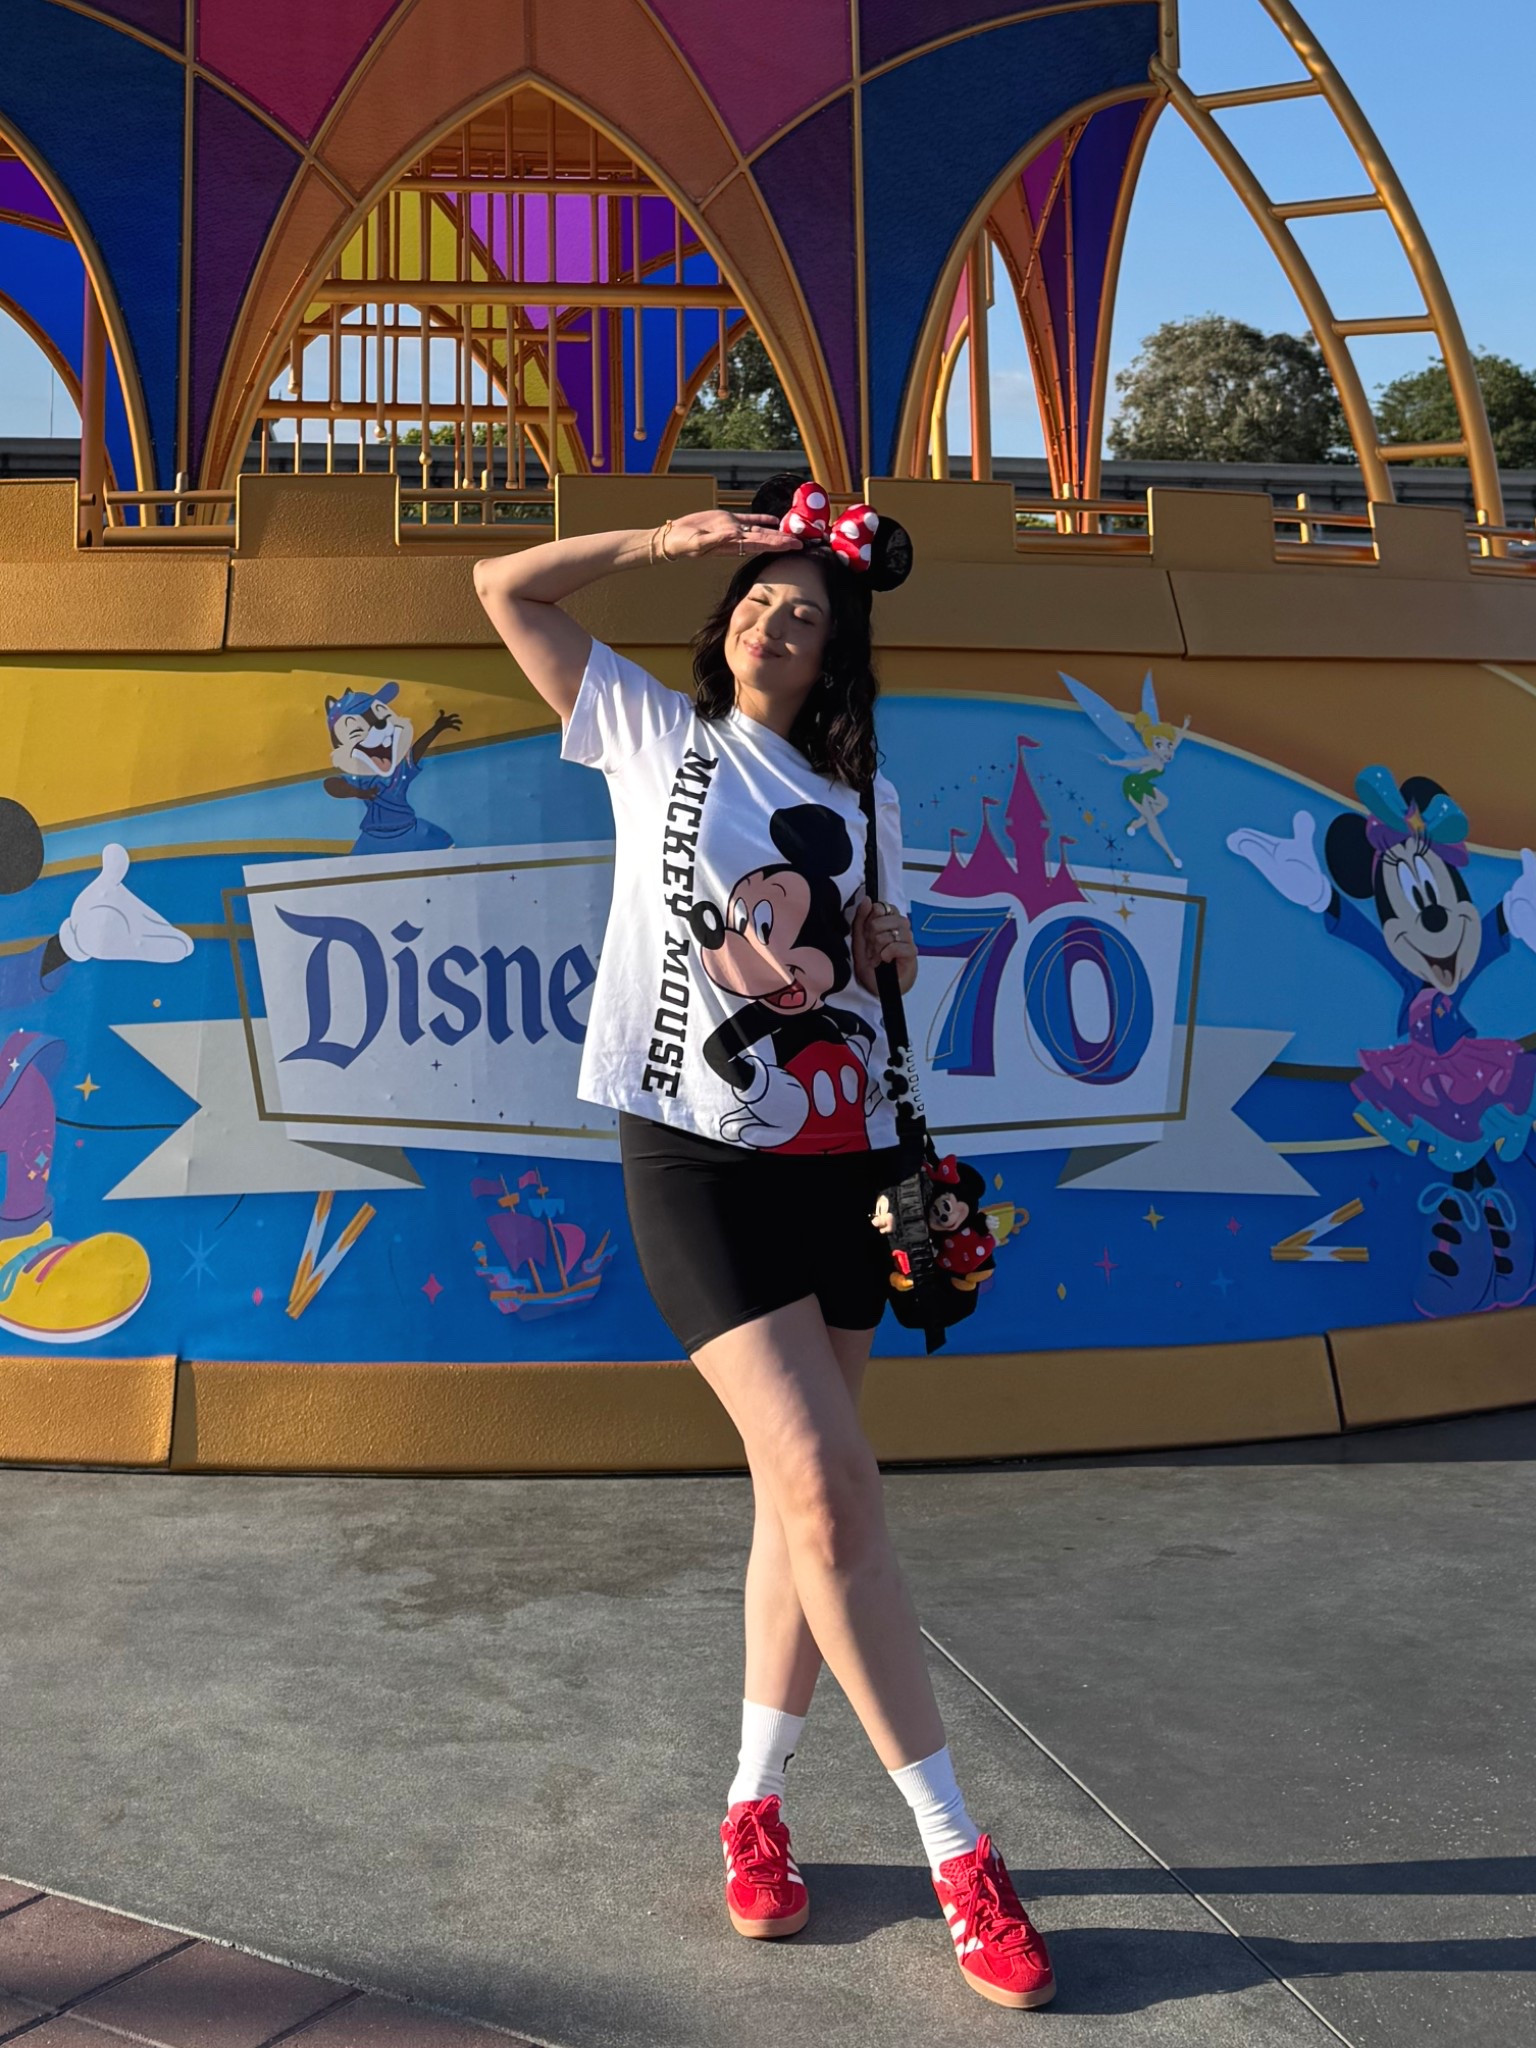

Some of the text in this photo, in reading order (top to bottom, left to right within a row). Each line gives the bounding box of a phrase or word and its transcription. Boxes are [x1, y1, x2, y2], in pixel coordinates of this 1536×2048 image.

[641, 748, 719, 1098] MICKEY MOUSE
[908, 900, 1154, 1086] 70
